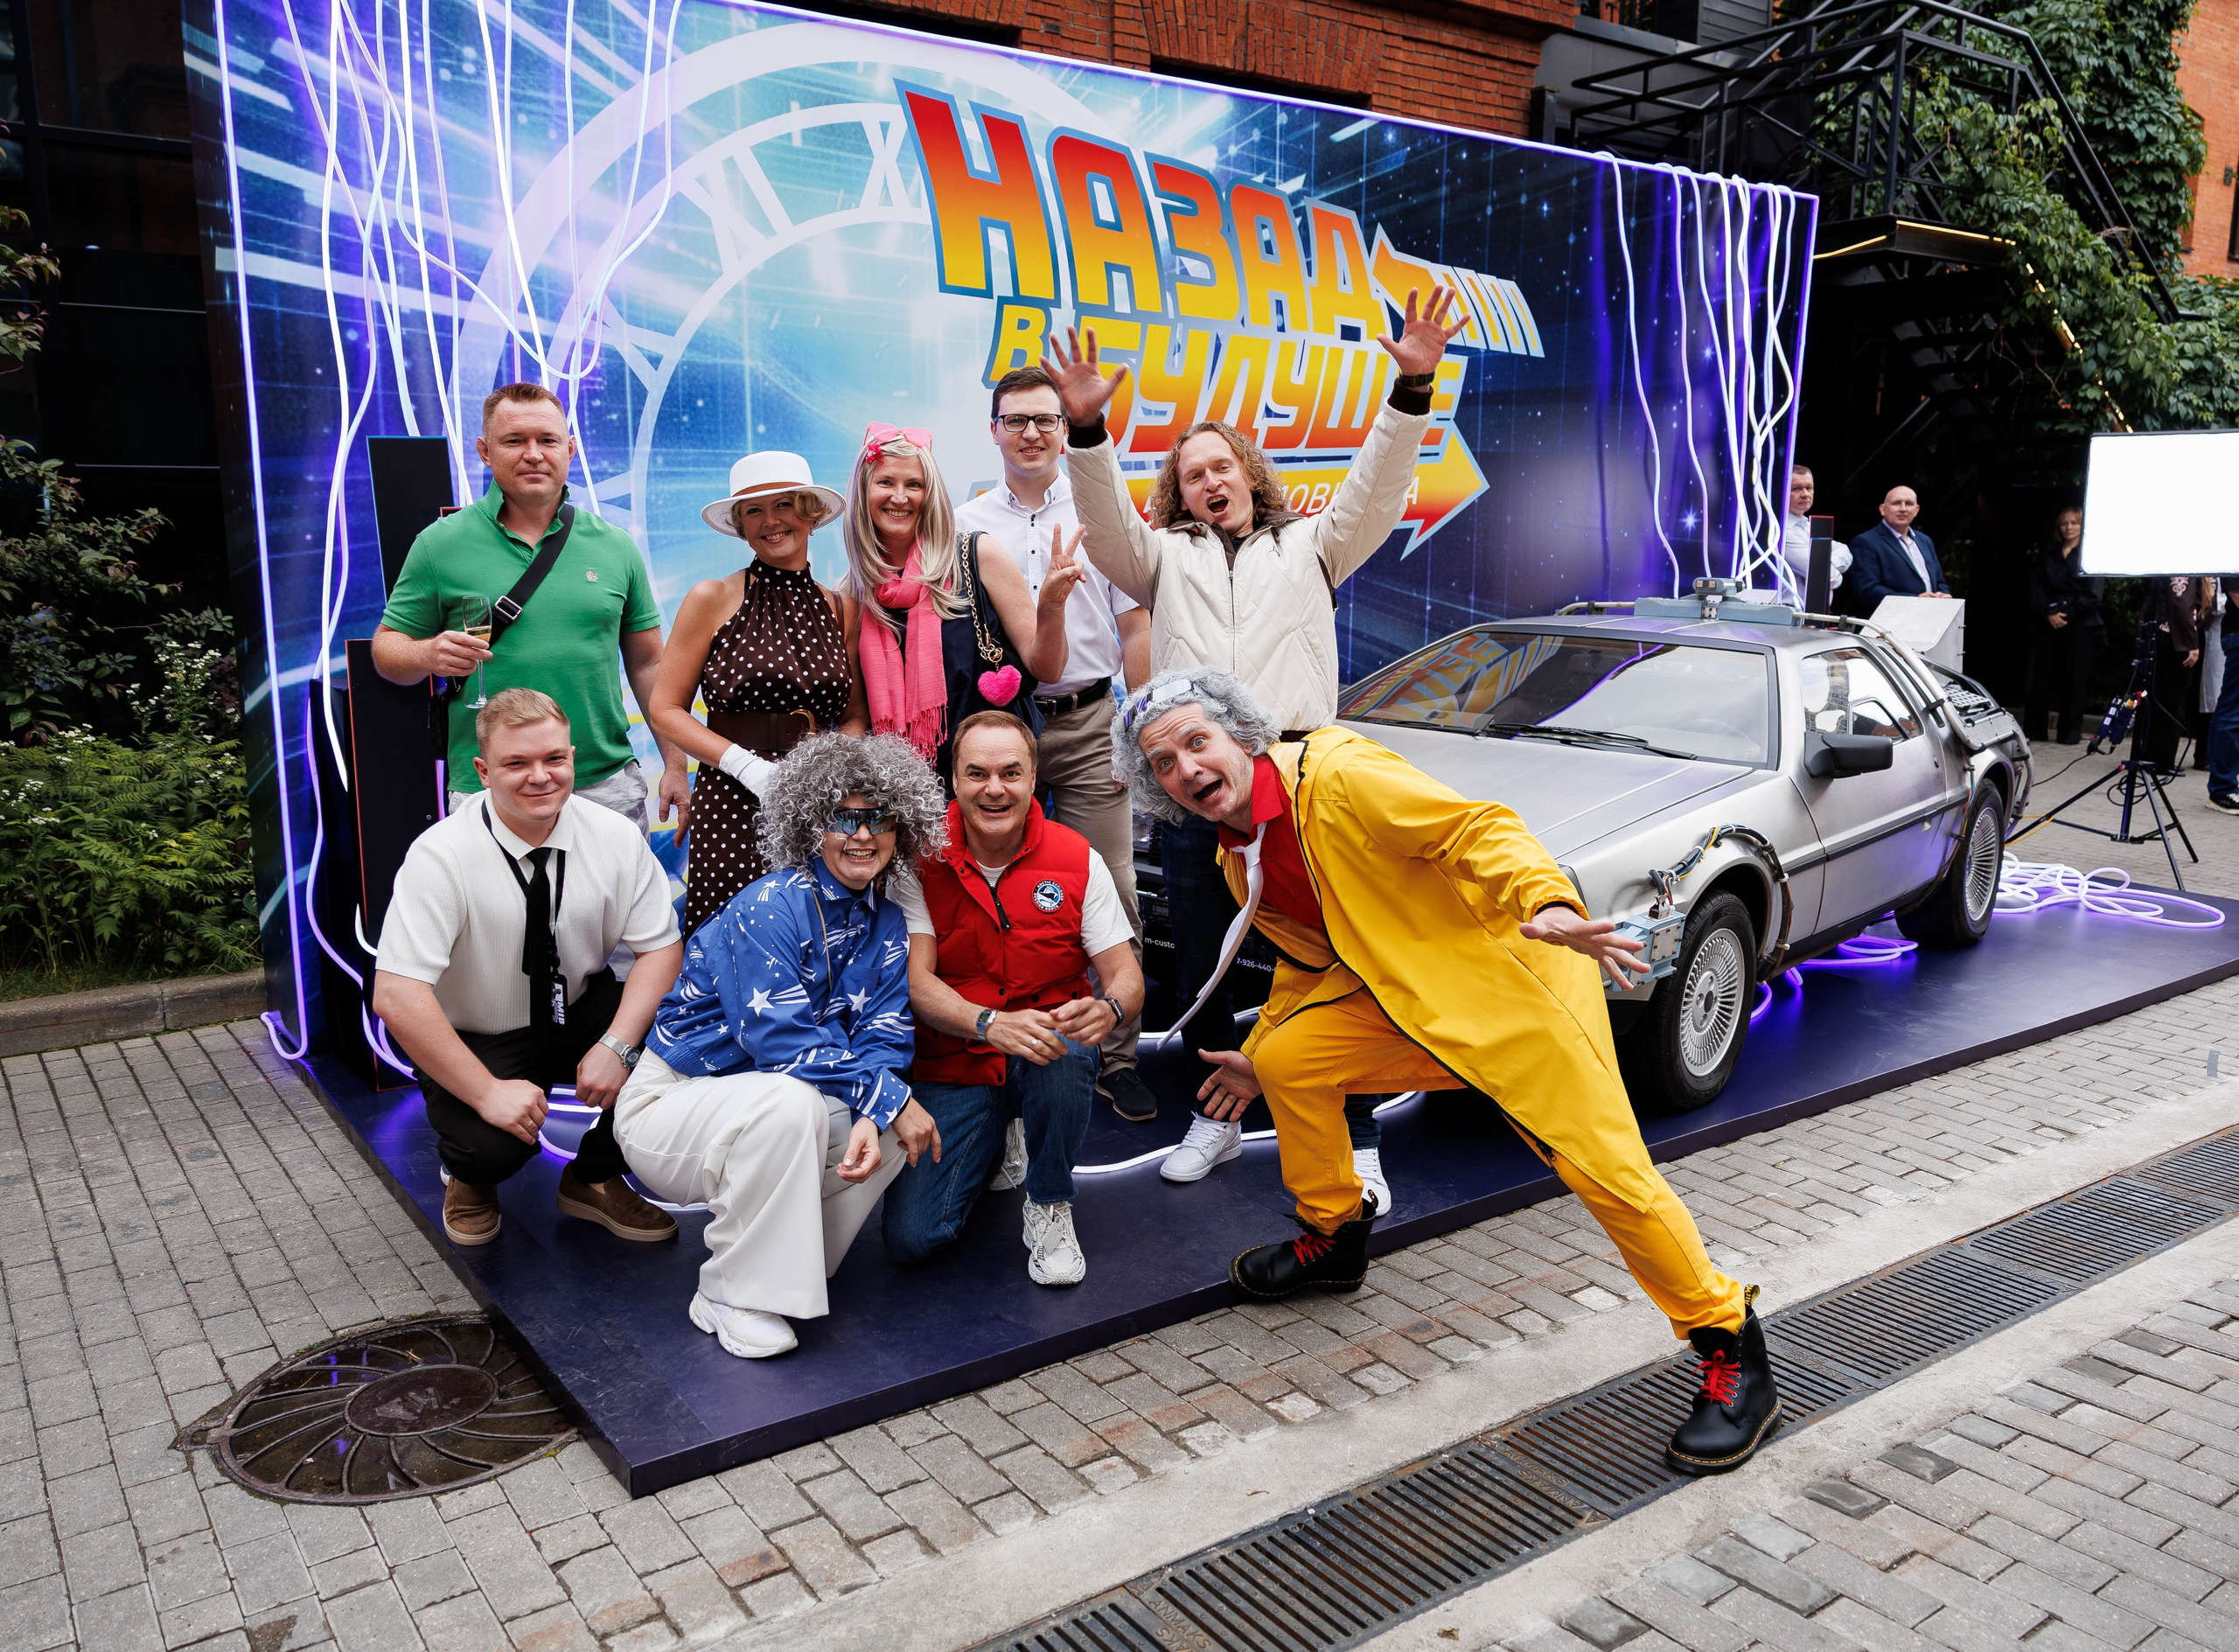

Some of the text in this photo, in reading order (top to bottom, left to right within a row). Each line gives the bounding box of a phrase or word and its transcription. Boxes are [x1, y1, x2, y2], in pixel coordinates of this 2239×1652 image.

[900, 84, 1385, 341] НАЗАД
[987, 303, 1047, 383] В
[1503, 1447, 1569, 1487] ANMAKS
[1516, 1469, 1587, 1509] ANMAKS
[1148, 1600, 1212, 1649] ANMAKS
